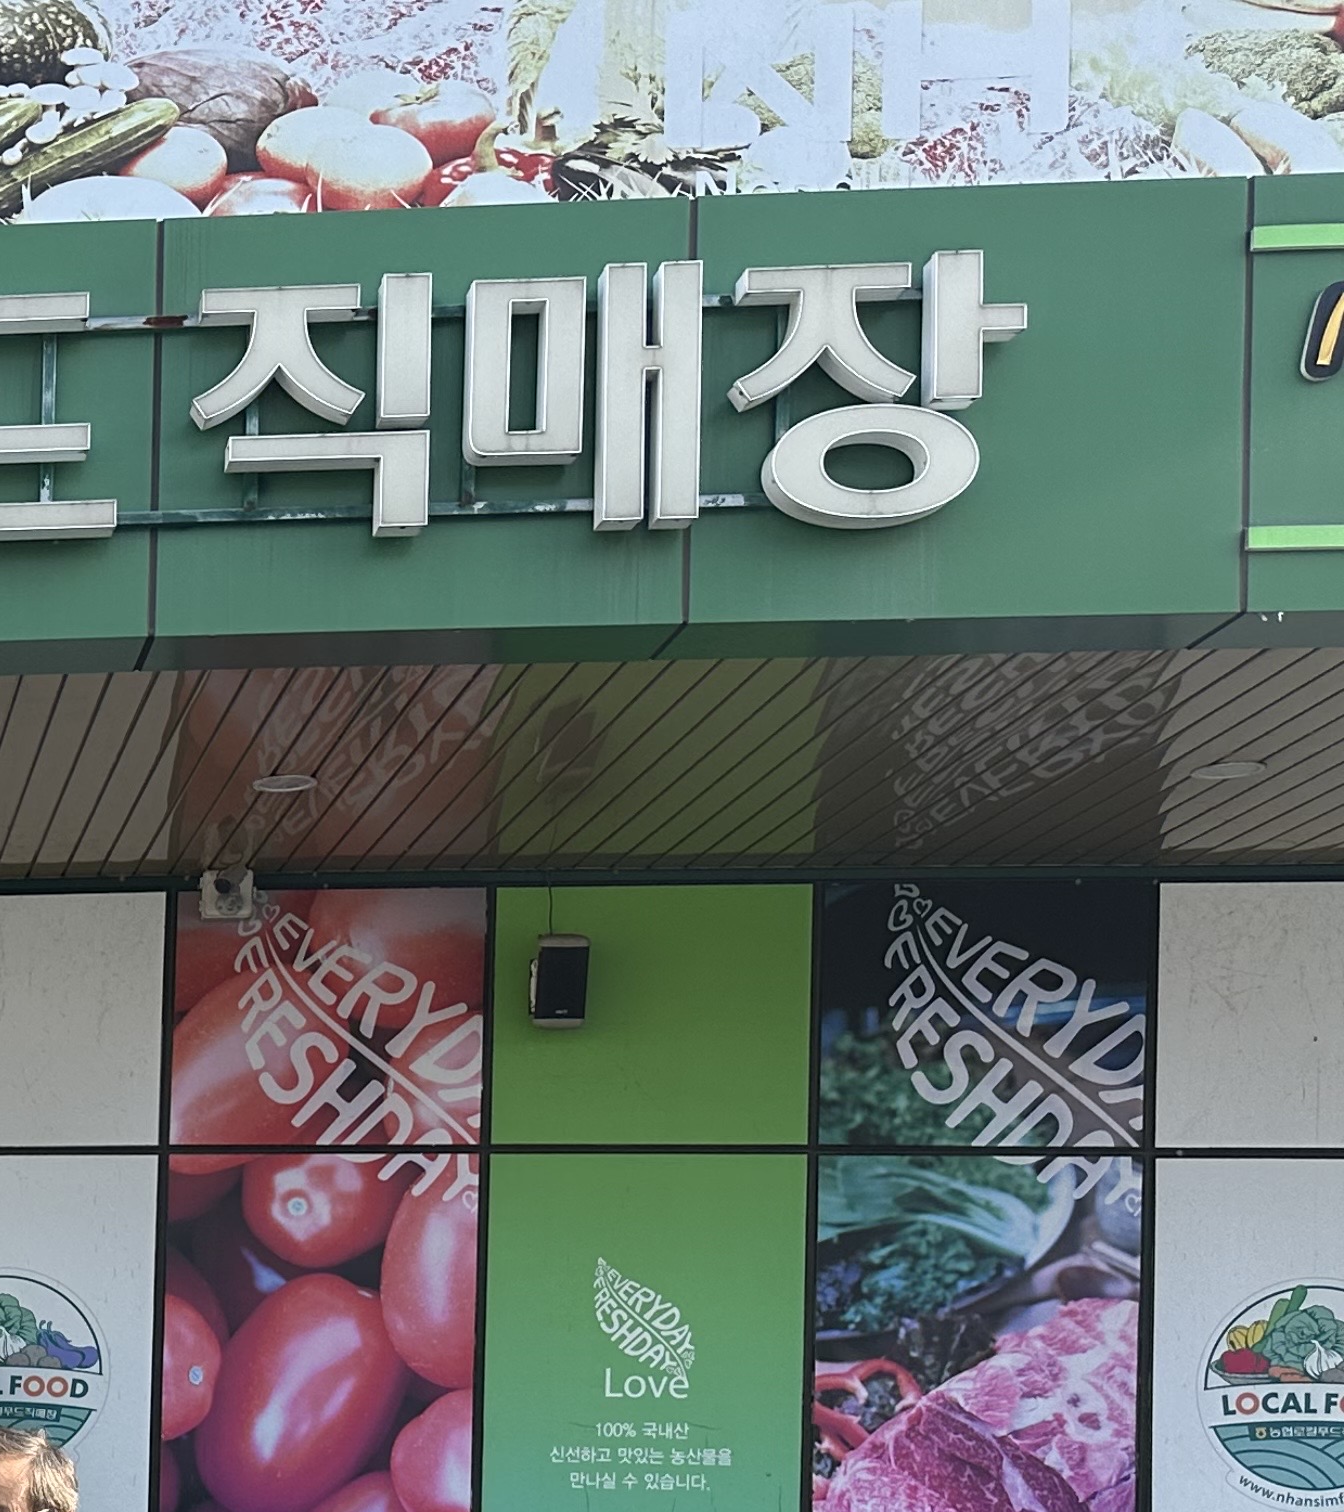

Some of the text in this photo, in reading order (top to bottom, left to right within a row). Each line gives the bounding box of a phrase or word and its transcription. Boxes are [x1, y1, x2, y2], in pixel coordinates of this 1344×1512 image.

[188, 247, 1028, 540] 직매장
[593, 1276, 678, 1371] FRESHDAY
[607, 1267, 695, 1354] EVERYDAY
[9, 1375, 90, 1399] FOOD
[604, 1367, 690, 1399] Love
[1221, 1391, 1318, 1417] LOCAL
[595, 1422, 690, 1440] 100% 국내산
[549, 1446, 732, 1467] 신선하고 맛있는 농산물을
[569, 1471, 711, 1492] 만나실 수 있습니다.
